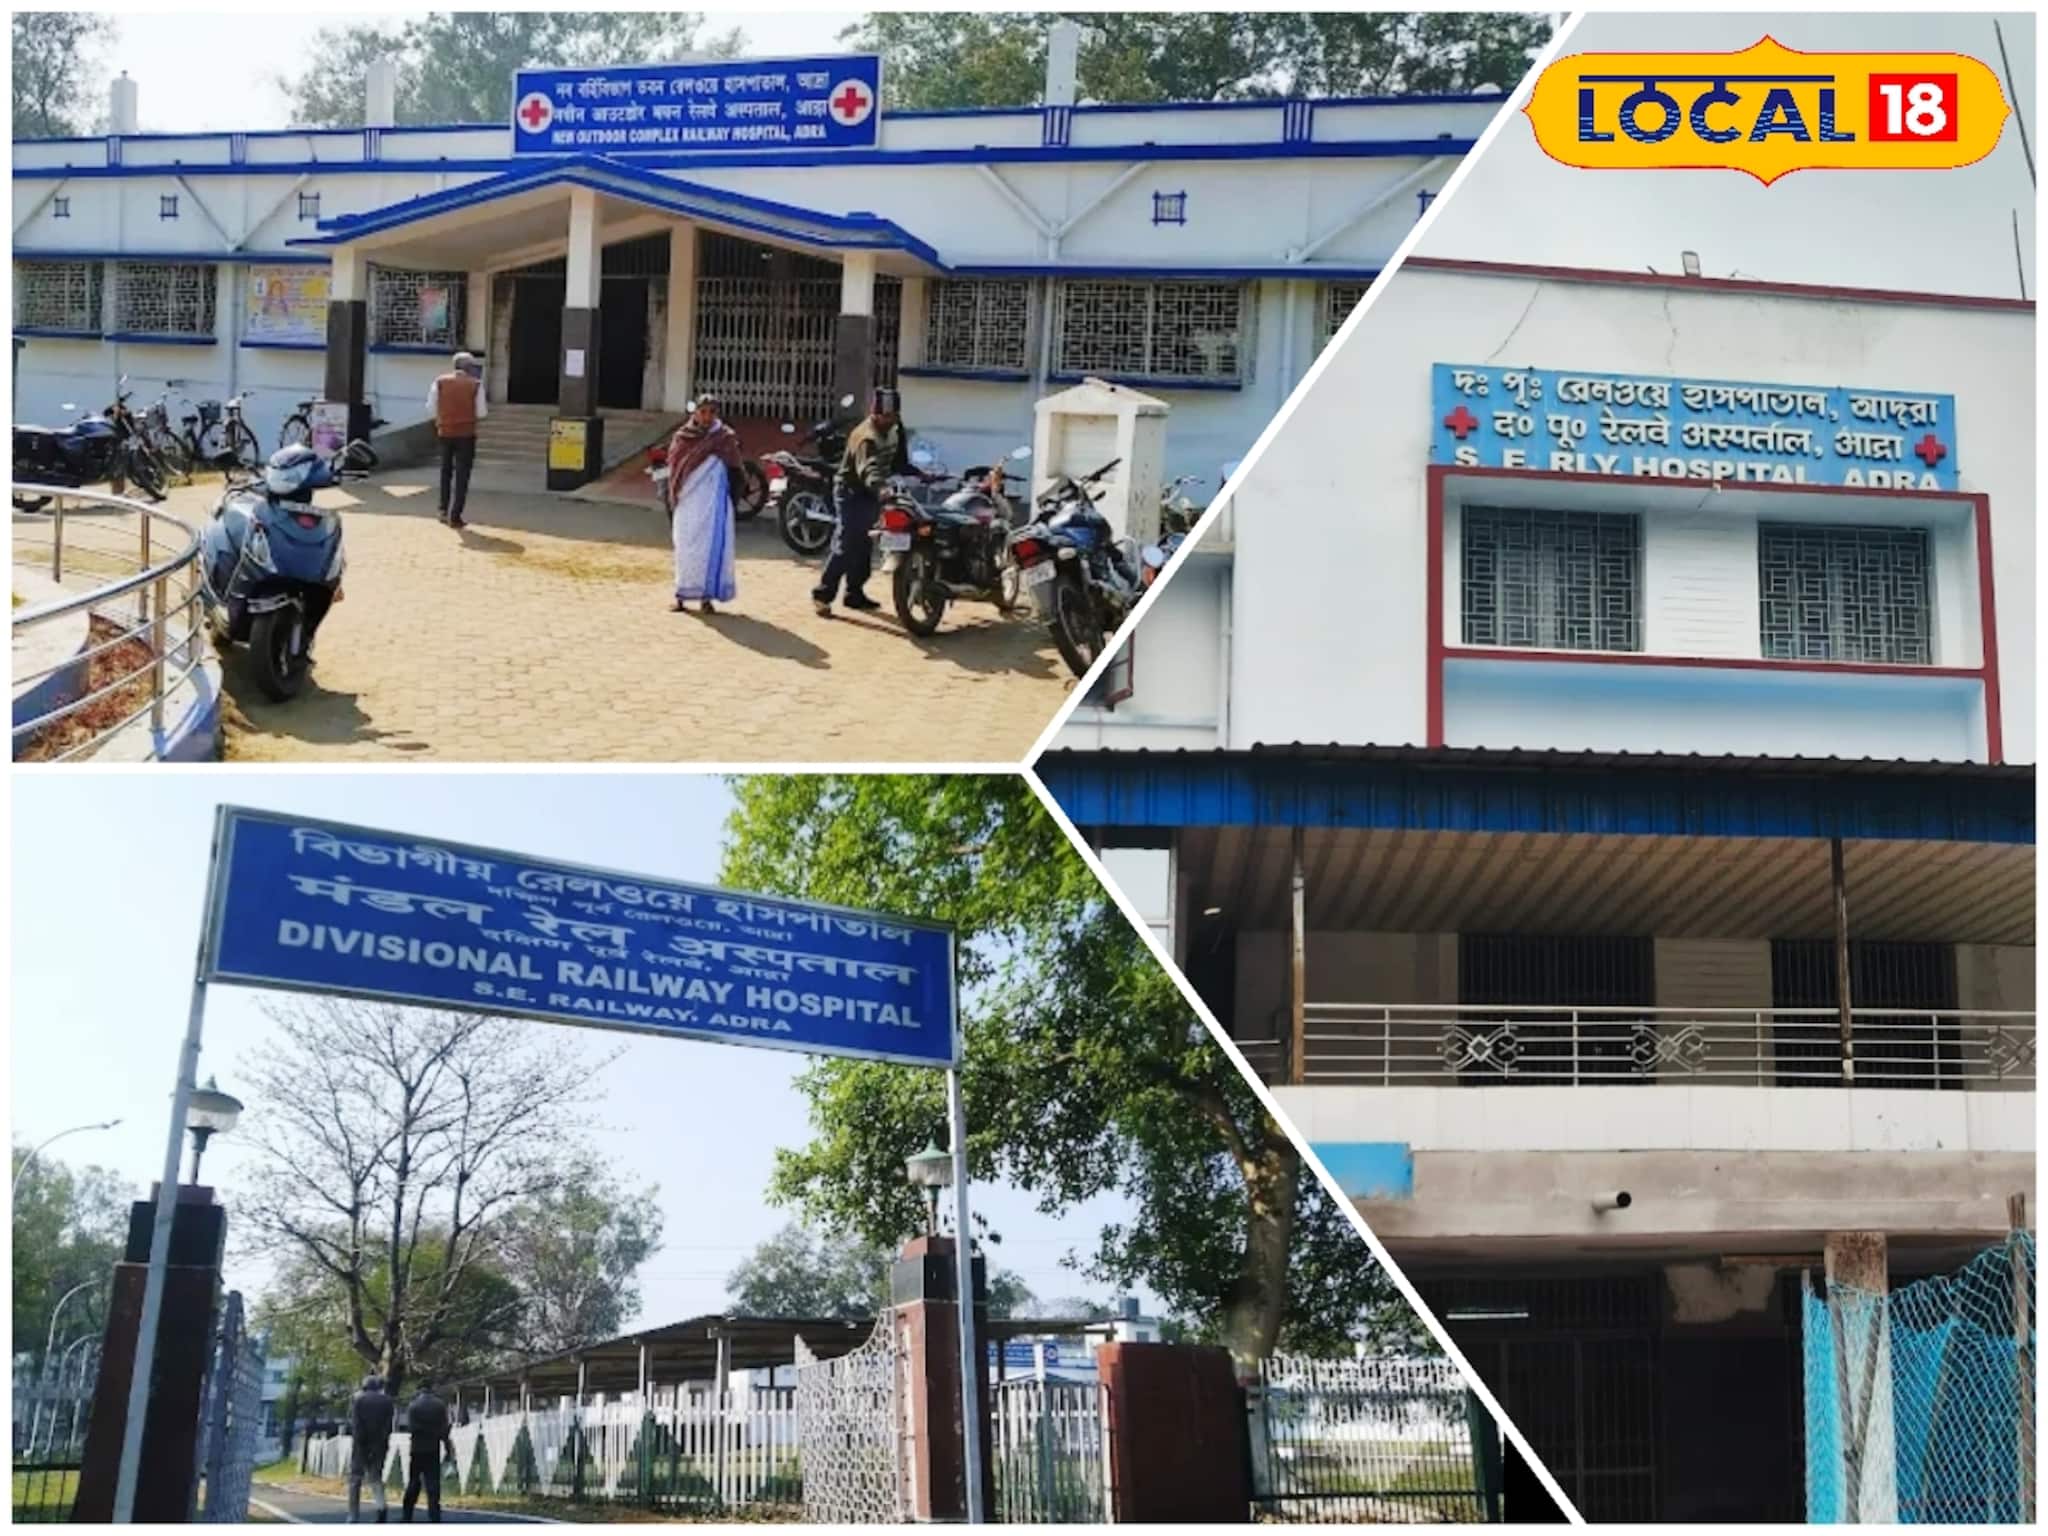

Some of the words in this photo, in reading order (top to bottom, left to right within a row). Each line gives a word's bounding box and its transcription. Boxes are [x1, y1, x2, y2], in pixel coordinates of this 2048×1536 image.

[552, 130, 575, 145] NEW
[575, 129, 627, 144] OUTDOOR
[628, 127, 680, 144] COMPLEX
[682, 126, 730, 142] RAILWAY
[731, 123, 792, 142] HOSPITAL,
[793, 123, 827, 139] ADRA
[1600, 406, 1671, 445] रेलवे
[1842, 468, 1942, 491] ADRA
[289, 828, 495, 882] বিভাগীয়
[517, 869, 697, 913] রেলওয়ে
[713, 899, 913, 946] হাসপাতাল
[288, 873, 494, 925] मंडल
[522, 904, 636, 945] रेल
[669, 935, 917, 985] अस्पताल
[278, 919, 542, 980] DIVISIONAL
[557, 960, 733, 1005] RAILWAY
[747, 985, 921, 1028] HOSPITAL
[472, 980, 537, 1003] S.E.
[708, 1013, 792, 1032] ADRA
